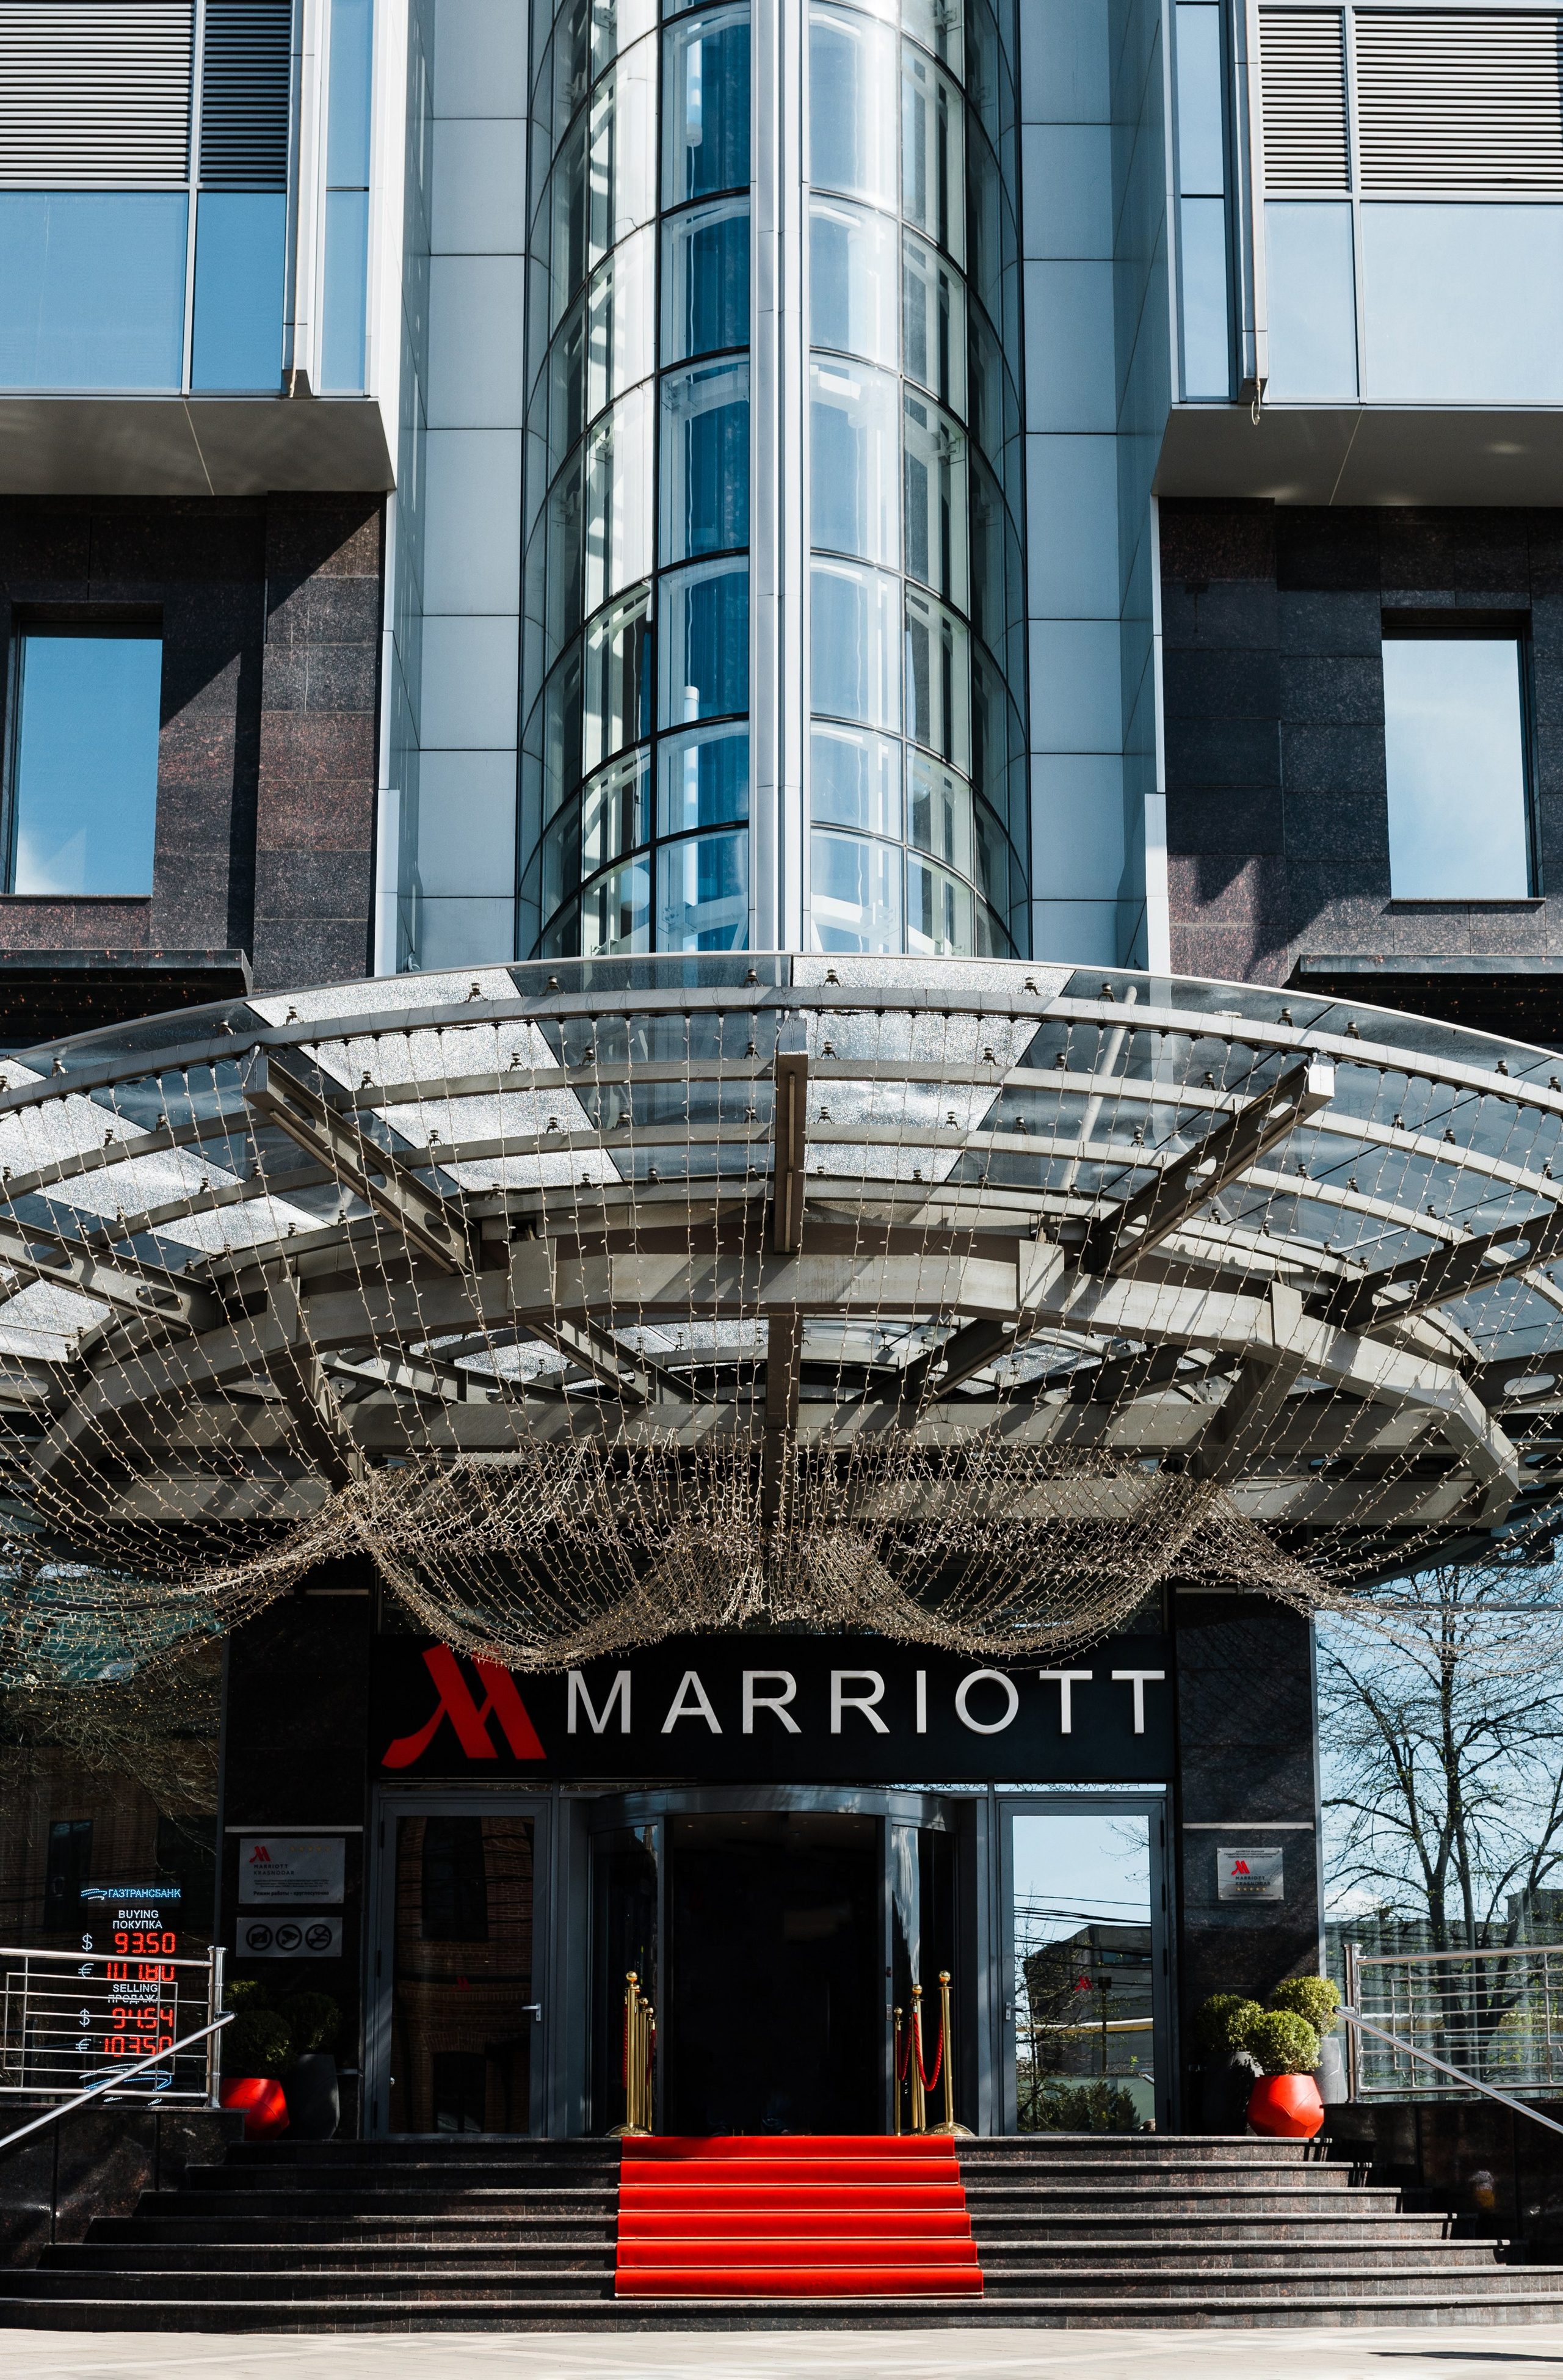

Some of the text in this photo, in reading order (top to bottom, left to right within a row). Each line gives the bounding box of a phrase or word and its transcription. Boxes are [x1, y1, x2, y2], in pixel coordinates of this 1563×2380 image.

[567, 1668, 1166, 1735] MARRIOTT
[107, 1888, 182, 1898] ГАЗТРАНСБАНК
[118, 1910, 159, 1919] BUYING
[112, 1920, 162, 1929] ПОКУПКА
[82, 1932, 176, 1953] $ 93.50
[112, 1984, 158, 1993] SELLING
[107, 1994, 159, 2004] ПРОДАЖ
[79, 2008, 90, 2027] $
